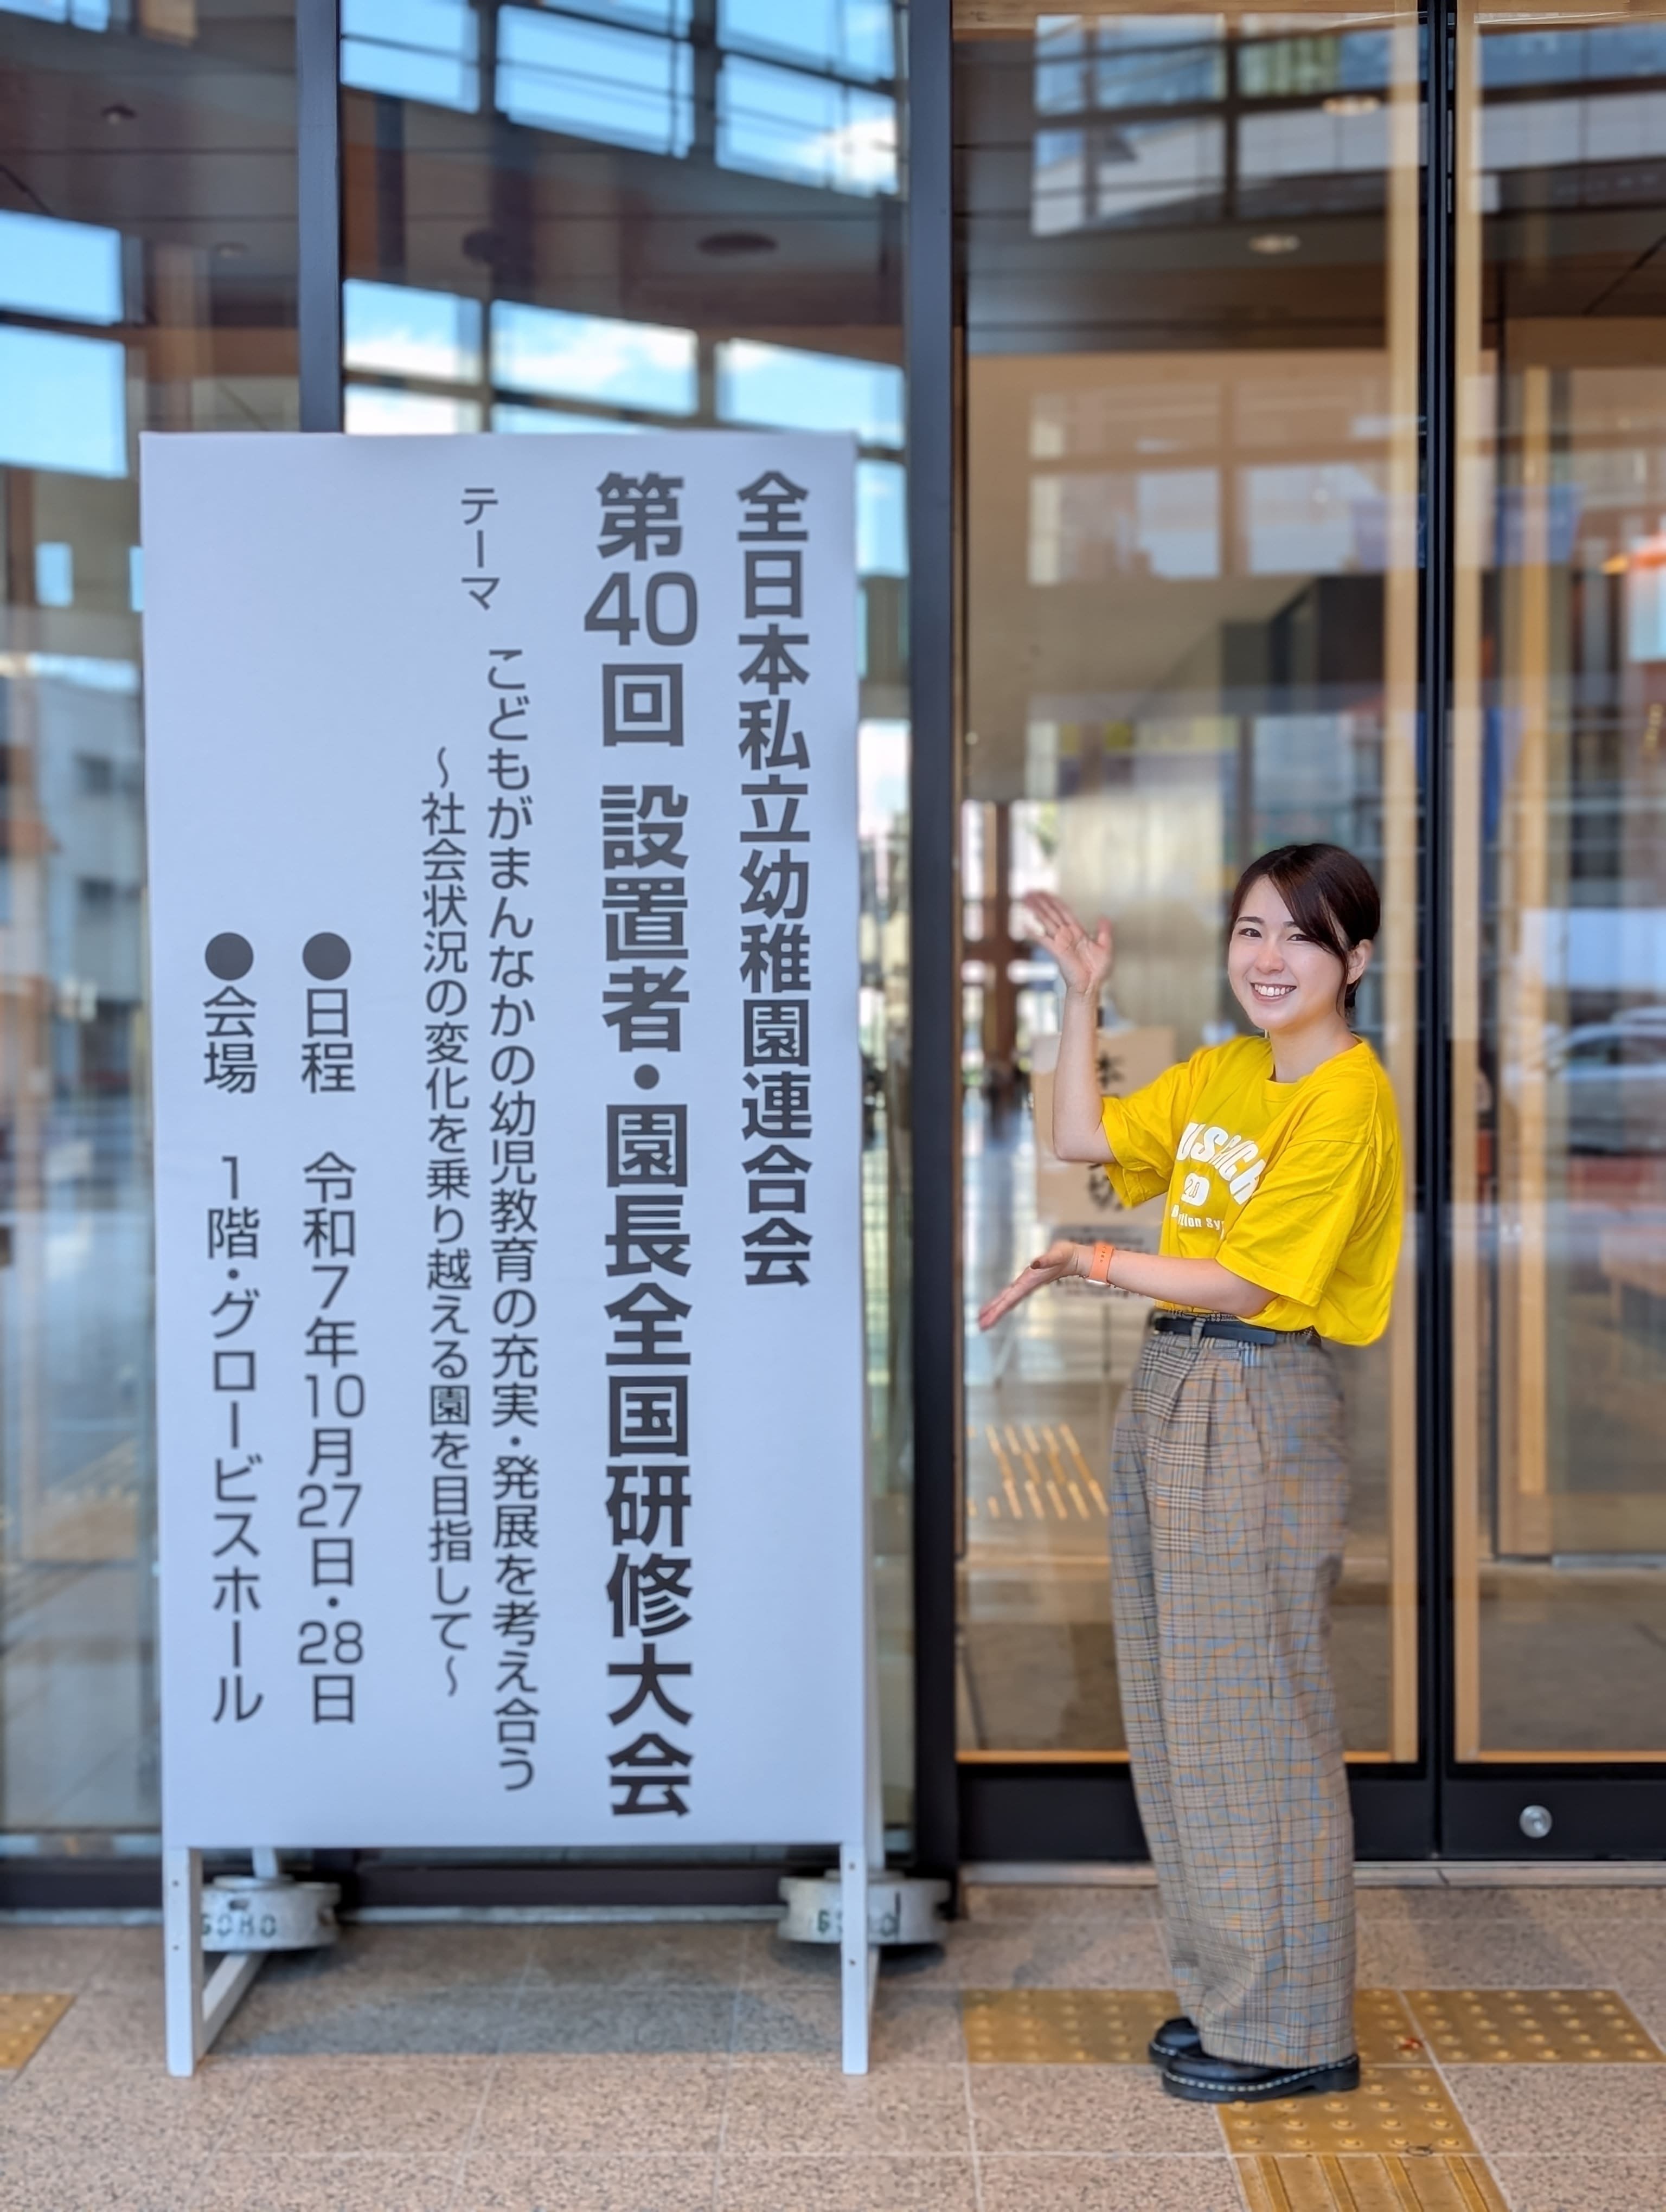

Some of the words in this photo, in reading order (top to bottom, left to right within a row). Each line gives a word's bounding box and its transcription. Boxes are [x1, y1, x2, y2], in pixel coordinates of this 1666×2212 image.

[461, 488, 500, 610] テーマ
[737, 470, 813, 1287] 全日本私立幼稚園連合会
[208, 1156, 264, 1722] 1階・グロービスホール
[298, 1151, 365, 1724] 令和7年10月27日・28日
[488, 649, 540, 1791] こどもがまんなかの幼児教育の充実・発展を考え合う
